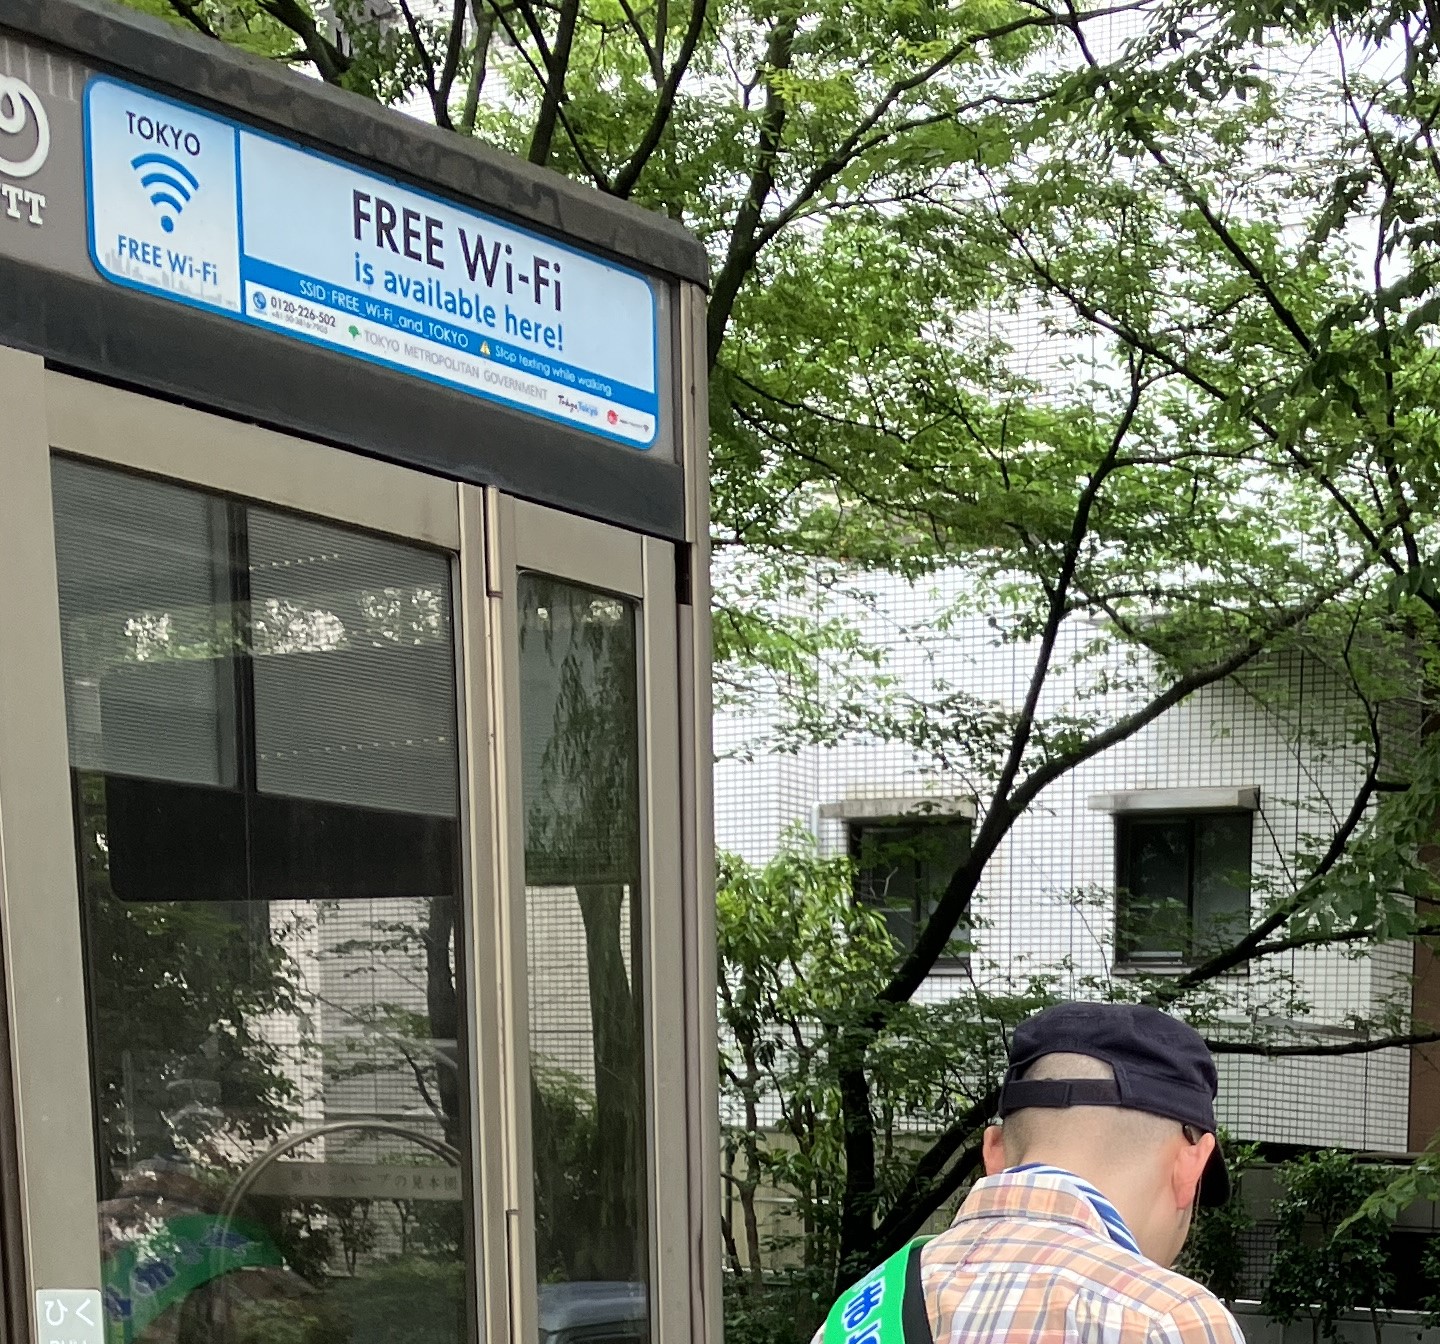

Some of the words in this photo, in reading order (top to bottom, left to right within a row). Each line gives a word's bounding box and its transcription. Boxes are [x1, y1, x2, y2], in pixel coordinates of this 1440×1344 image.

[125, 110, 201, 156] TOKYO
[0, 183, 47, 225] TT
[117, 234, 163, 268] FREE
[167, 249, 218, 286] Wi-Fi
[354, 188, 445, 270] FREE
[458, 226, 562, 312] Wi-Fi
[270, 295, 337, 328] 0120-226-502
[354, 252, 375, 285] is
[384, 268, 497, 329] available
[505, 303, 564, 352] here!
[364, 329, 400, 353] TOKYO
[404, 343, 480, 379] METROPOLITAN
[483, 369, 548, 401] GOVERNMENT
[494, 345, 517, 364] Stop
[518, 352, 550, 377] texting
[552, 366, 576, 383] while
[578, 376, 613, 397] walking
[44, 1298, 95, 1327] ひく
